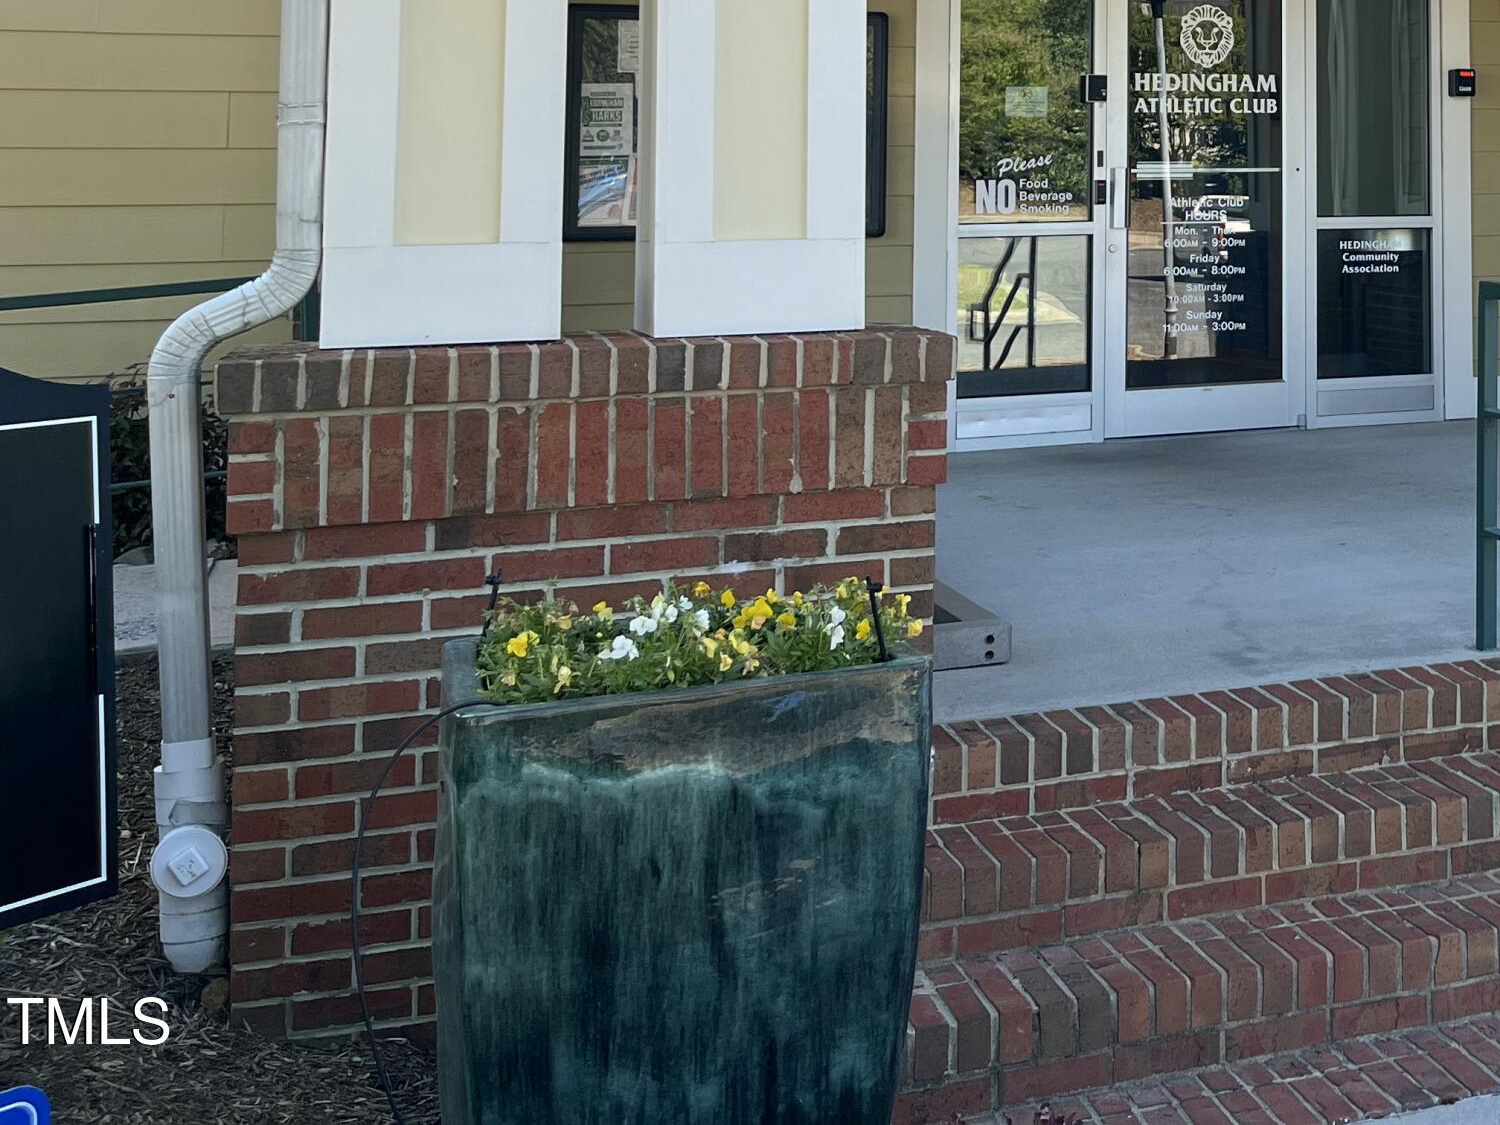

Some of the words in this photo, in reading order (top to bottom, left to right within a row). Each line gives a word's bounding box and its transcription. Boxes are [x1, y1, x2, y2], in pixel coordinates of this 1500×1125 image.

[1134, 72, 1278, 93] HEDINGHAM
[1133, 97, 1224, 114] ATHLETIC
[1229, 98, 1278, 114] CLUB
[996, 154, 1053, 178] Please
[1019, 178, 1049, 189] Food
[975, 178, 1017, 215] NO
[1019, 191, 1073, 202] Beverage
[1217, 196, 1244, 207] Club
[1019, 203, 1070, 216] Smoking
[1185, 209, 1227, 221] HOURS
[1174, 226, 1199, 236] Mon.
[1211, 237, 1246, 247] 9:00PM
[1339, 240, 1398, 250] HEDINGHA
[1189, 254, 1220, 264] Friday
[1342, 252, 1399, 262] Community
[1211, 265, 1246, 275] 8:00PM
[1341, 264, 1399, 274] Association
[1186, 283, 1227, 293] Saturday
[1213, 293, 1244, 303] 3:00PM
[1186, 310, 1222, 320] Sunday
[1211, 321, 1246, 331] 3:00PM
